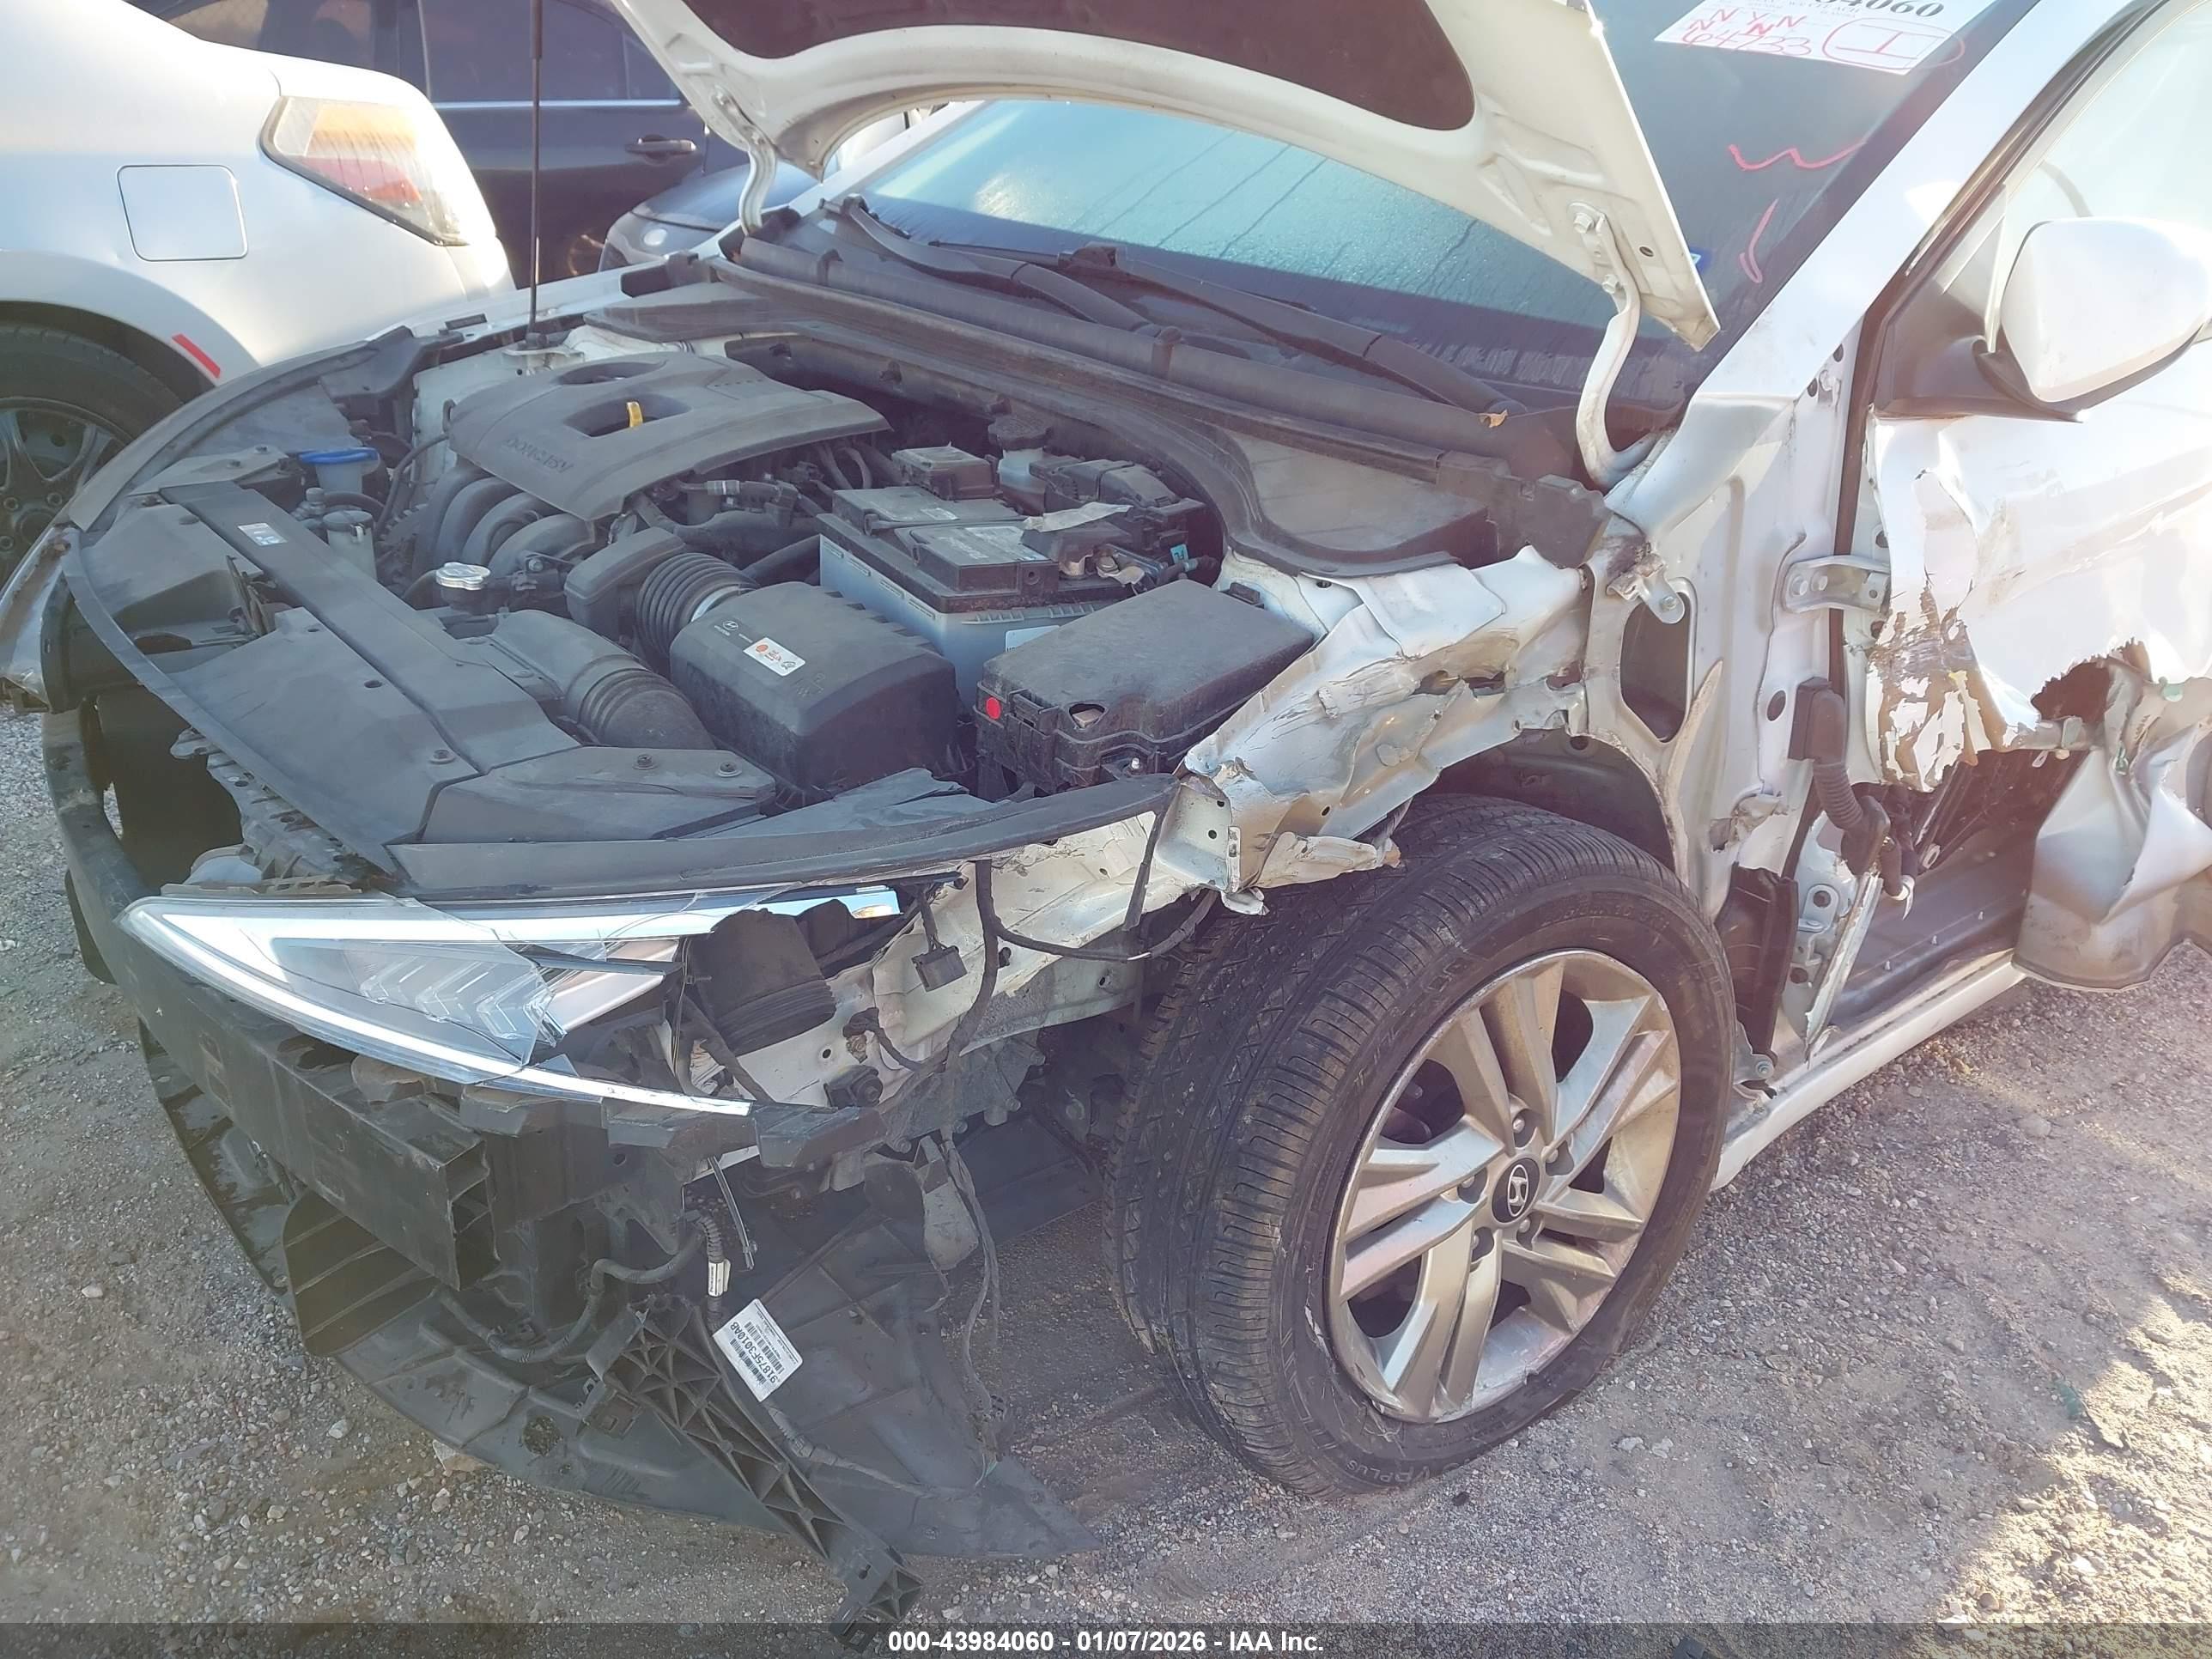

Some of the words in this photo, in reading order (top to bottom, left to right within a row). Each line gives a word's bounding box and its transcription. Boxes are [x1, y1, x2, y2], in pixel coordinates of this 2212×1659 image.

[1814, 0, 1944, 17] 060
[730, 1322, 778, 1383] 91875F3010AB
[1346, 1460, 1393, 1483] PLUS
